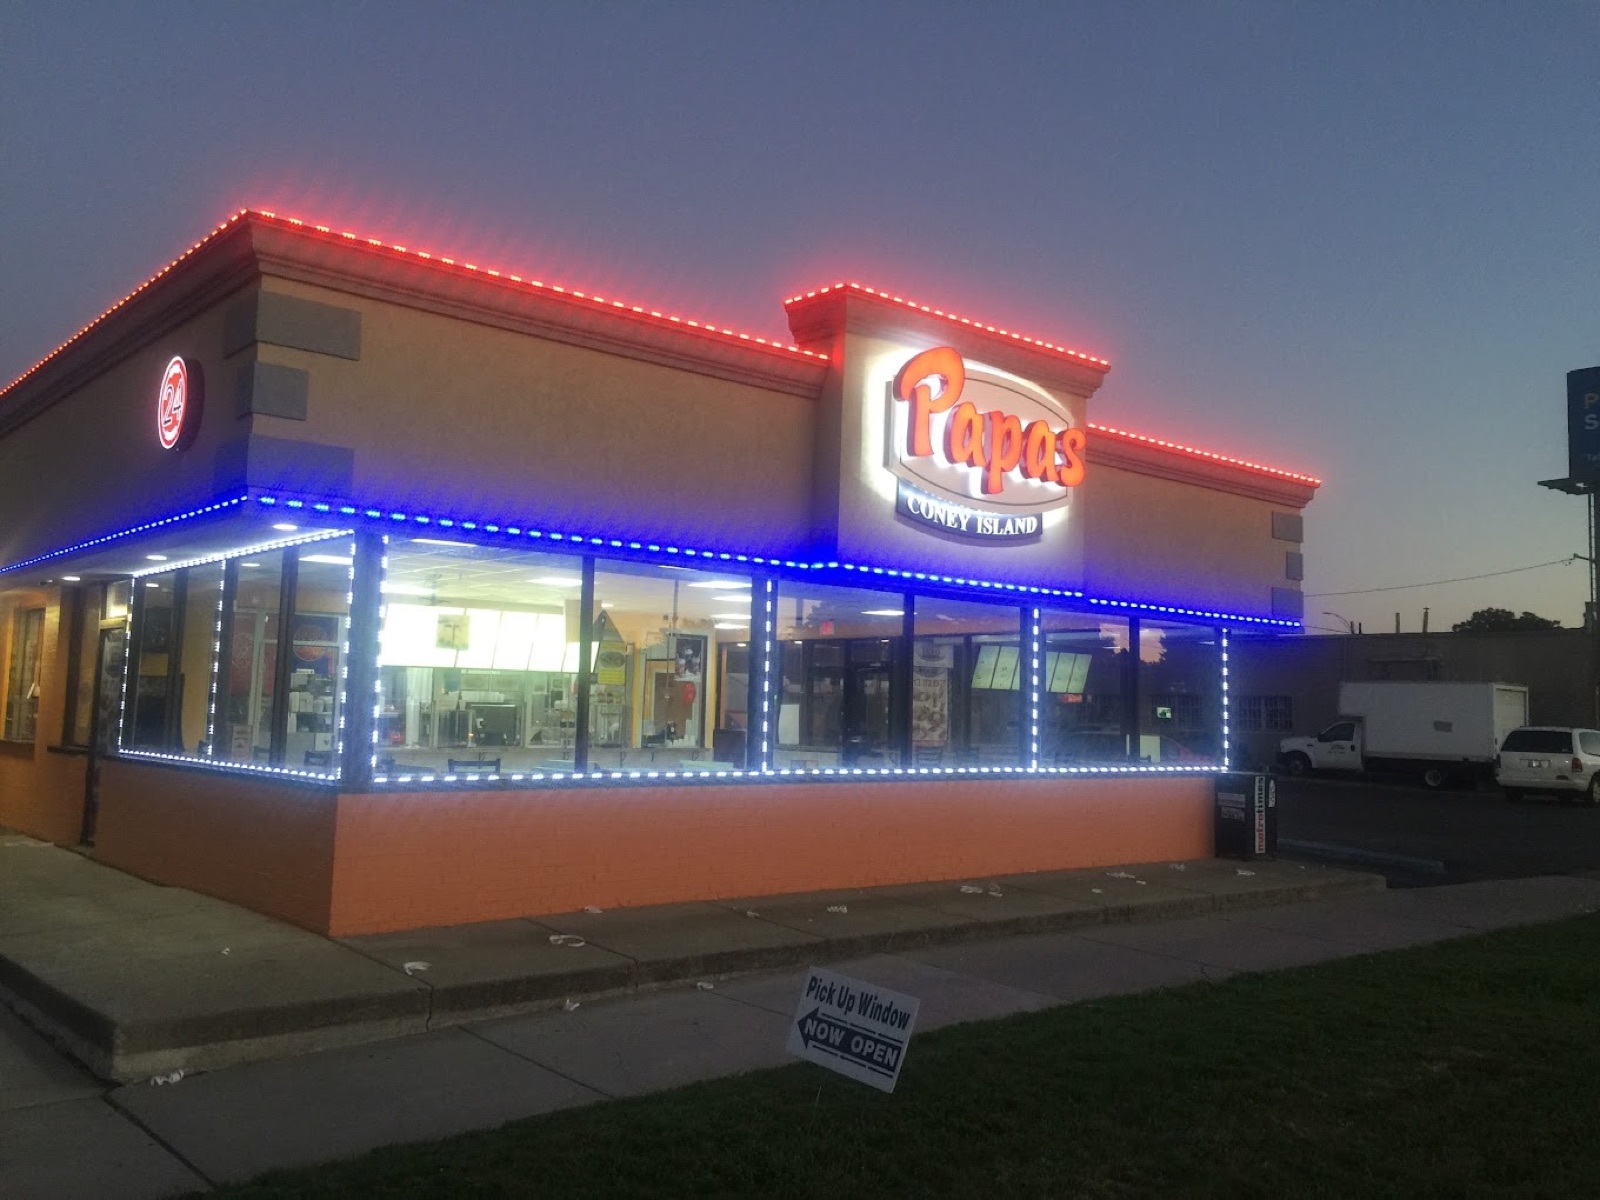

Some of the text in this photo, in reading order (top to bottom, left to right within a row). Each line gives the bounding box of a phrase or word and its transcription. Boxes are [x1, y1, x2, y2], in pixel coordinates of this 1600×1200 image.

[893, 346, 1086, 494] Papas
[907, 496, 1038, 535] CONEY ISLAND
[806, 976, 911, 1030] Pick Up Window
[804, 1018, 899, 1067] NOW OPEN
